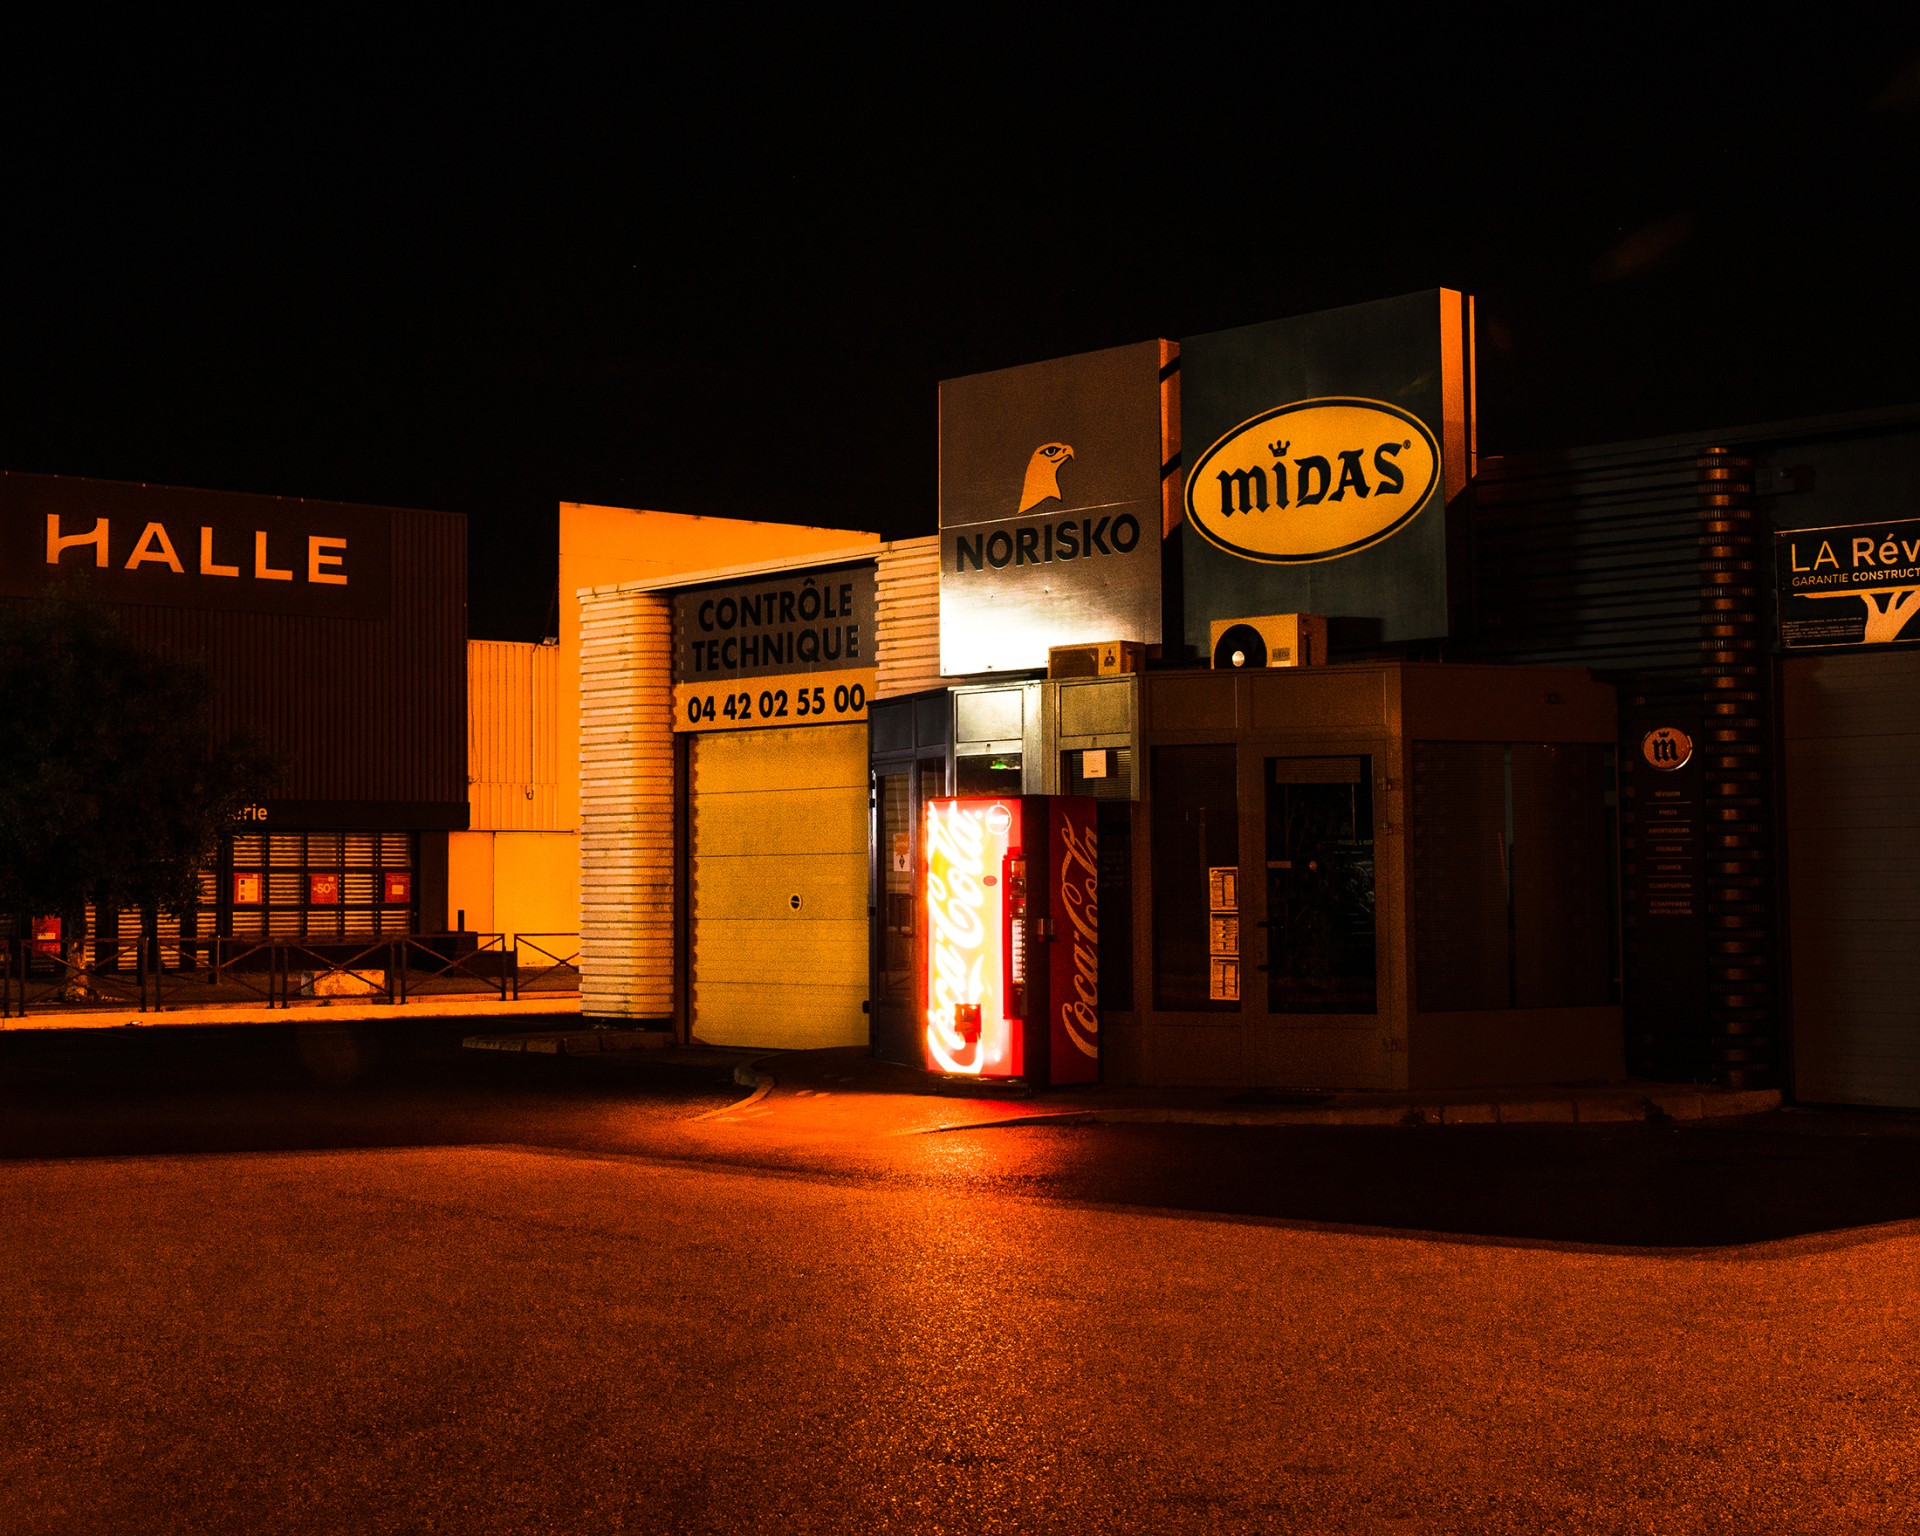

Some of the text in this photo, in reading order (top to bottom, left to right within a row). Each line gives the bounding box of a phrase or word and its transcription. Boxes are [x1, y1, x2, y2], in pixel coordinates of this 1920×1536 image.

[46, 513, 348, 585] HALLE
[956, 513, 1140, 573] NORISKO
[1791, 532, 1920, 572] LA Rév
[1792, 573, 1849, 587] GARANTIE
[698, 577, 853, 632] CONTRÔLE
[691, 624, 860, 672] TECHNIQUE
[688, 683, 865, 723] 04 42 02 55 00
